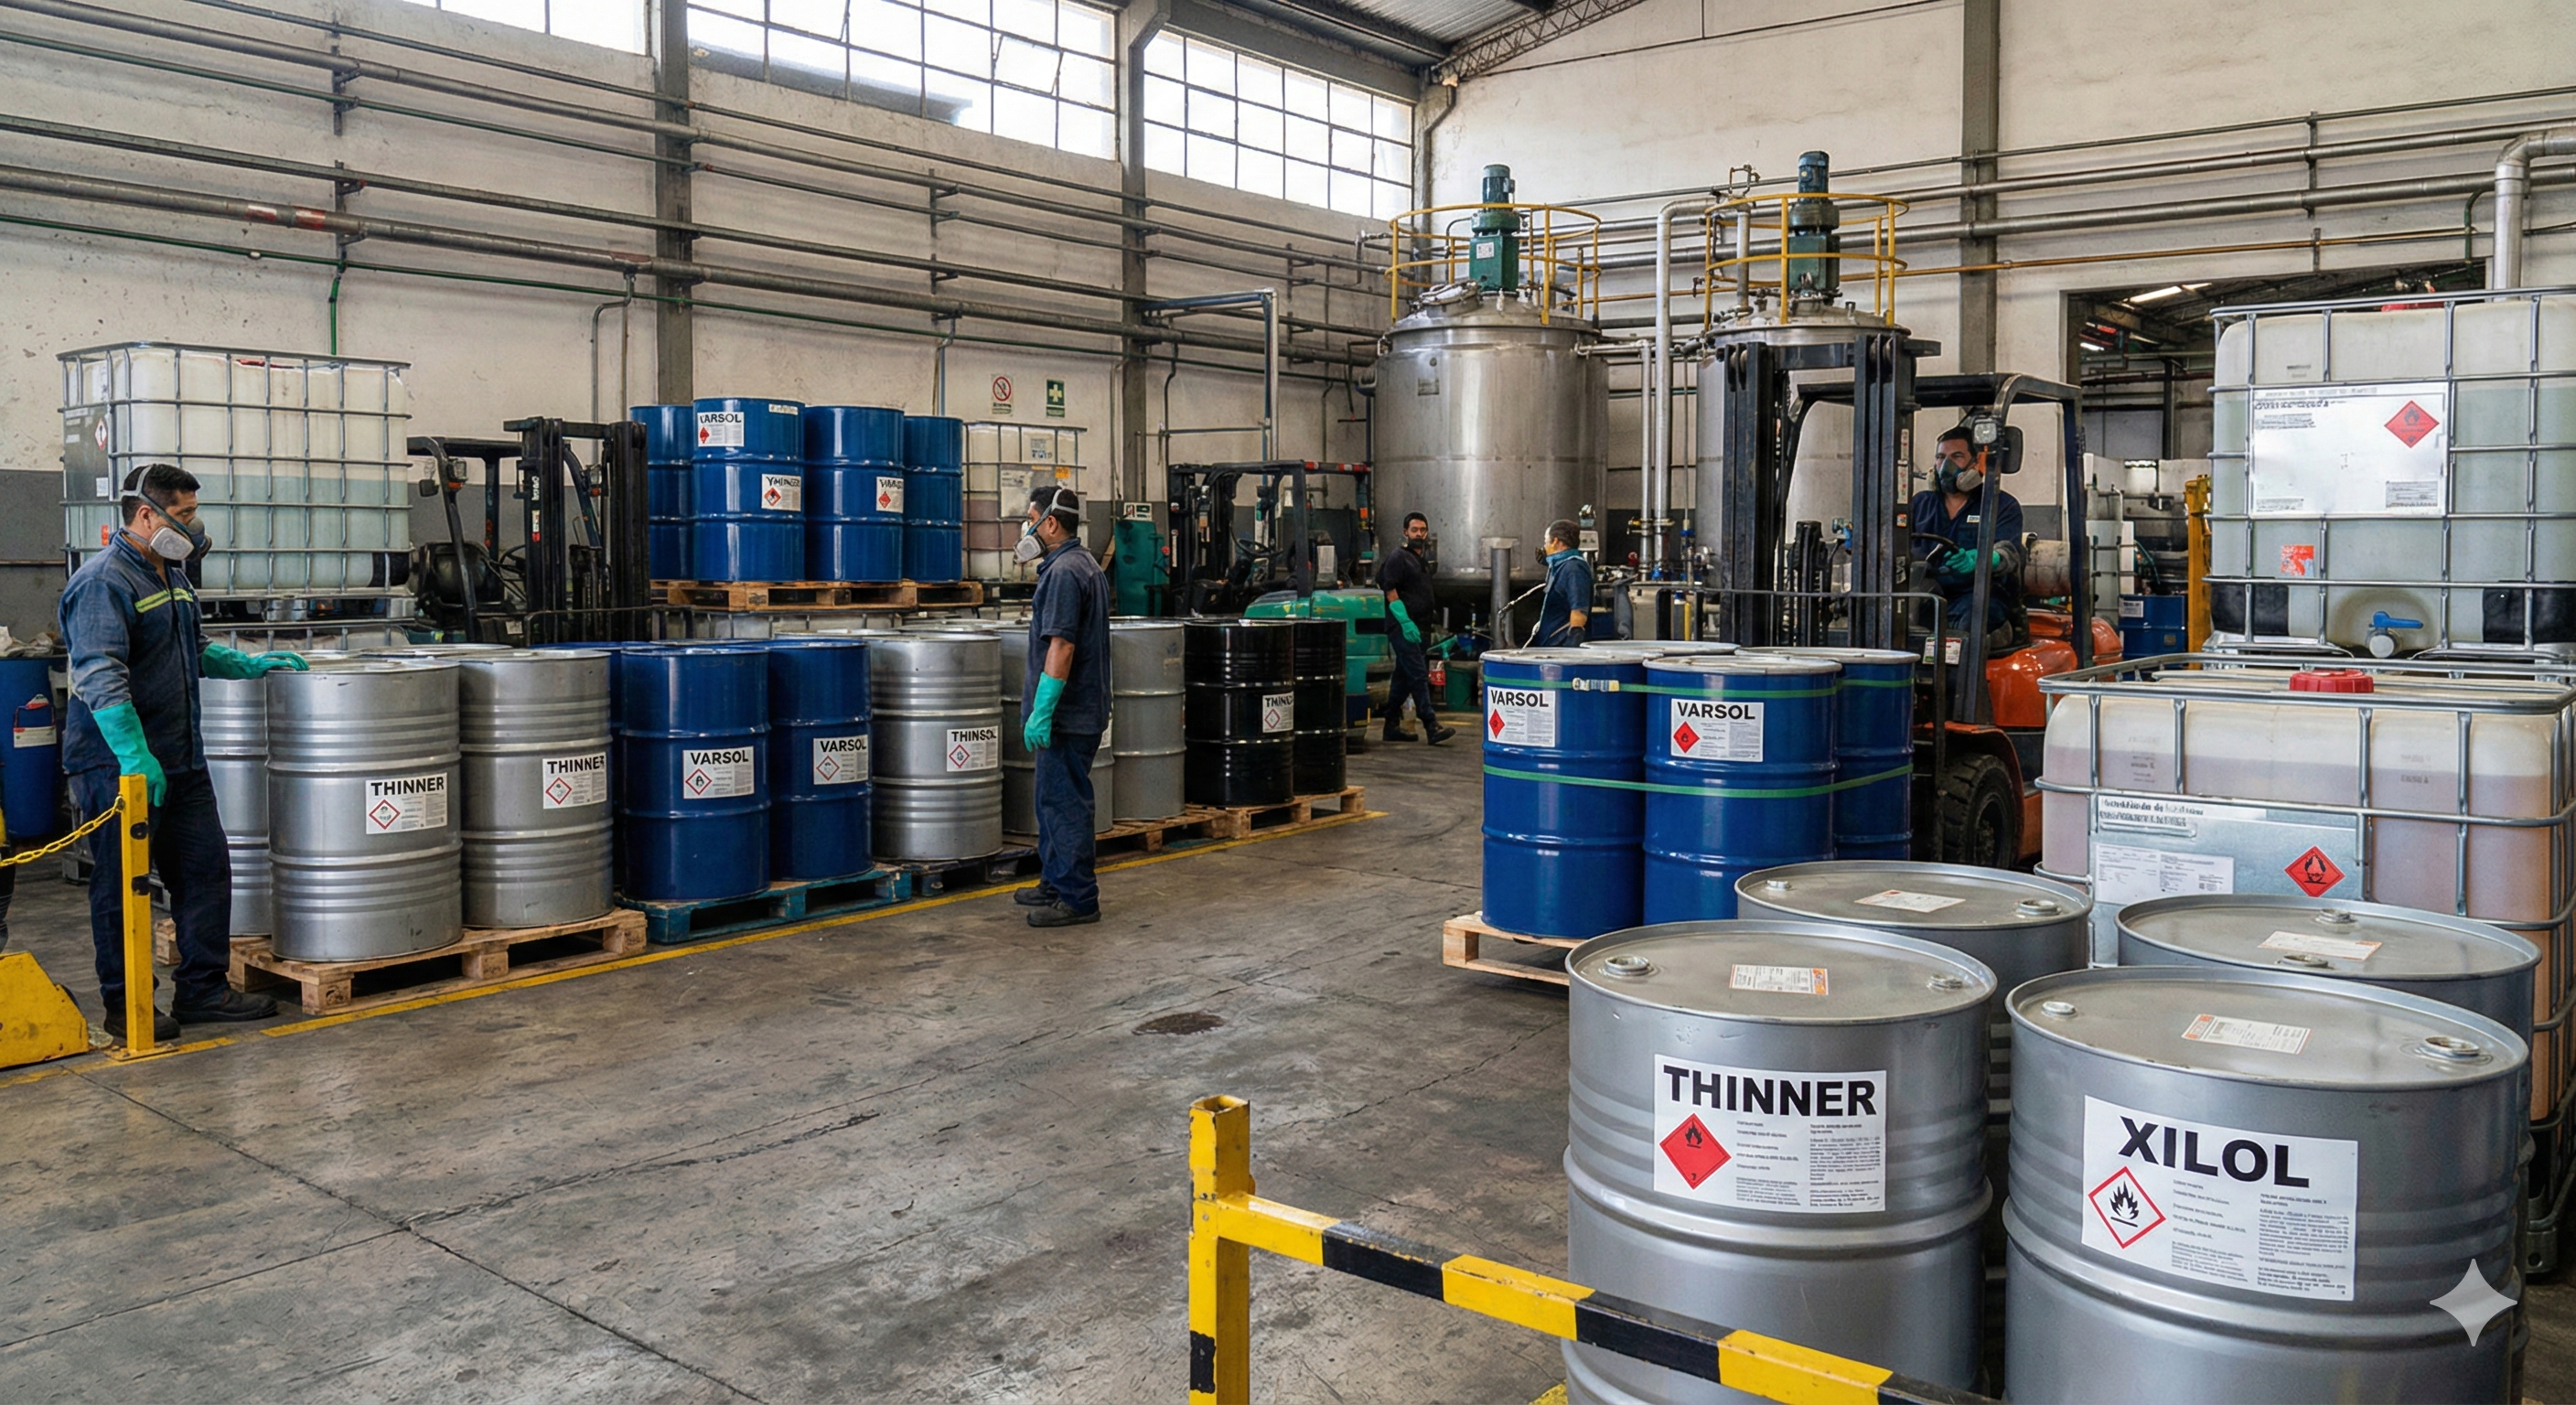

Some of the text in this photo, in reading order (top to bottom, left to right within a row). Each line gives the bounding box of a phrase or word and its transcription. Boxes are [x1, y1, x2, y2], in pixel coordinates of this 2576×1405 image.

[1490, 690, 1550, 708] VARSOL
[1677, 702, 1755, 720] VARSOL
[820, 738, 867, 753] VARSOL
[690, 749, 749, 766] VARSOL
[370, 777, 445, 797] THINNER
[1663, 1065, 1877, 1117] THINNER
[2118, 1115, 2310, 1189] XILOL
